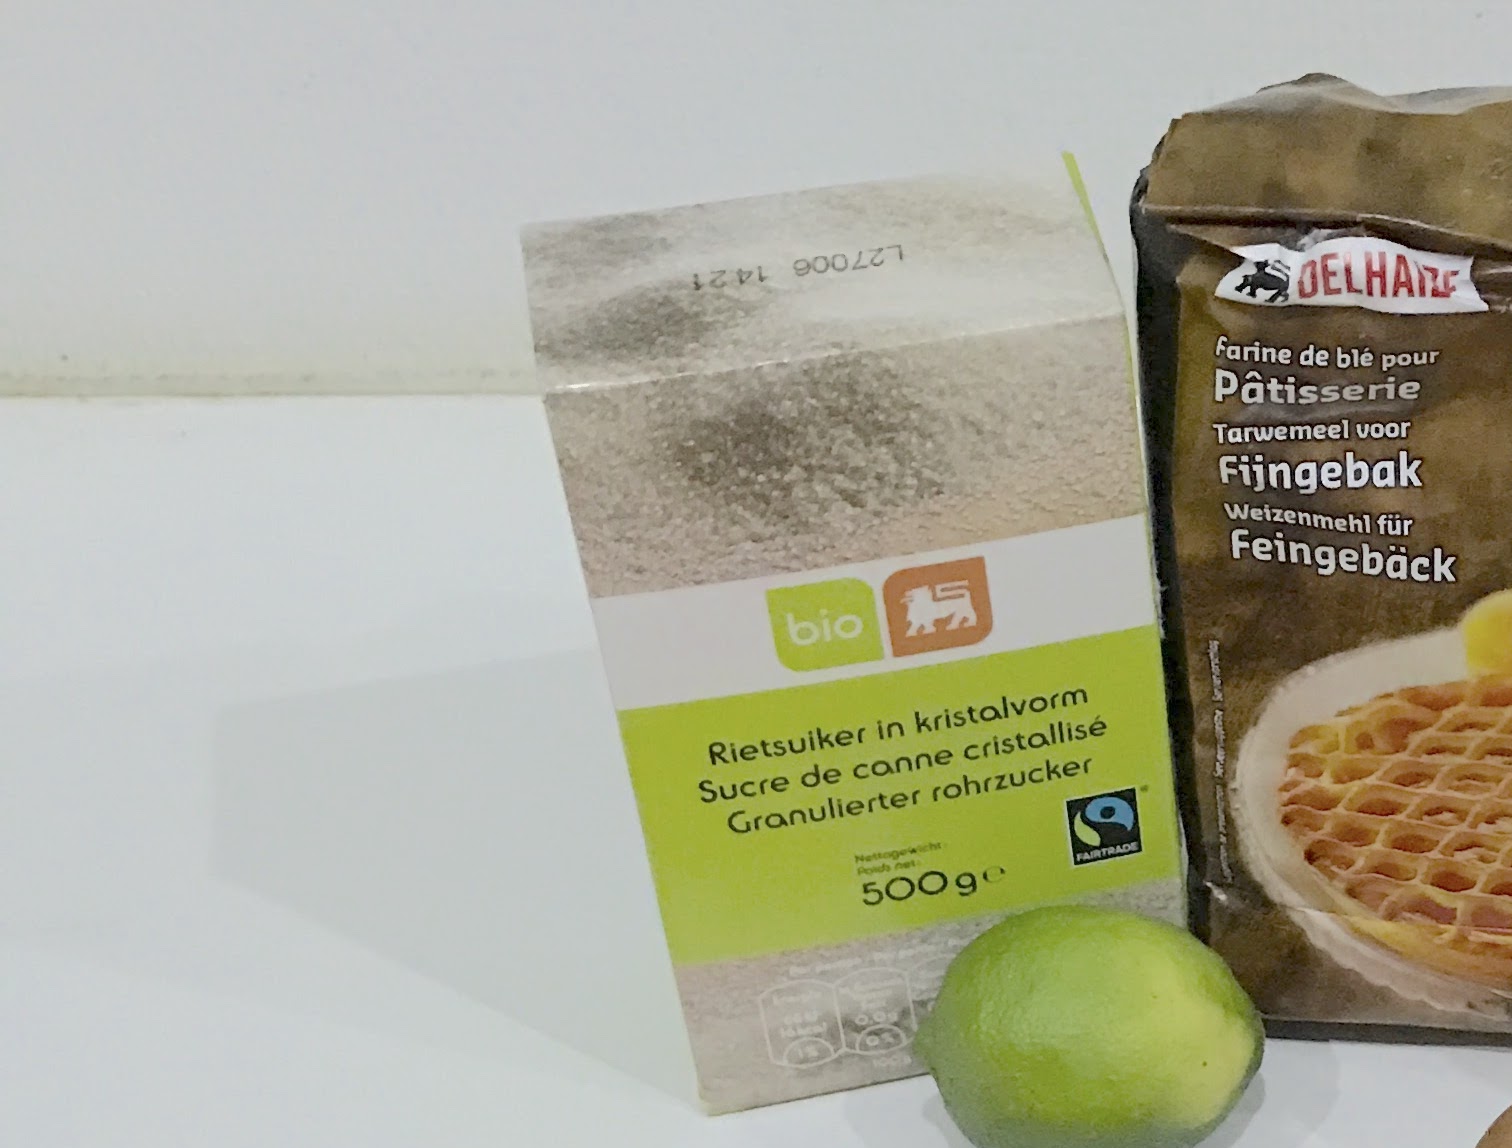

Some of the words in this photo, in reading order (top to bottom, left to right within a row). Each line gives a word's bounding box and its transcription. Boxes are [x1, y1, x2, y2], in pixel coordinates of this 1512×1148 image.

[793, 244, 903, 277] L27006
[1215, 336, 1292, 365] Farine
[1299, 343, 1330, 367] de
[1335, 345, 1374, 369] blé
[1381, 347, 1440, 372] pour
[1214, 368, 1421, 405] Pâtisserie
[1213, 419, 1350, 445] Tarwemeel
[1356, 421, 1412, 440] voor
[1219, 450, 1424, 495] Fijngebak
[1223, 501, 1372, 535] Weizenmehl
[1378, 511, 1413, 537] für
[1230, 529, 1457, 583] Feingebäck
[786, 608, 863, 646] bio
[708, 725, 866, 765] Rietsuiker
[878, 719, 905, 741] in
[914, 687, 1088, 734] kristalvorm
[699, 776, 790, 803] Sucre
[800, 764, 842, 789] de
[852, 750, 953, 781] canne
[964, 715, 1107, 762] cristallisé
[727, 786, 921, 834] Granulierter
[932, 755, 1092, 803] rohrzucker
[1075, 841, 1140, 862] FAIRTRADE
